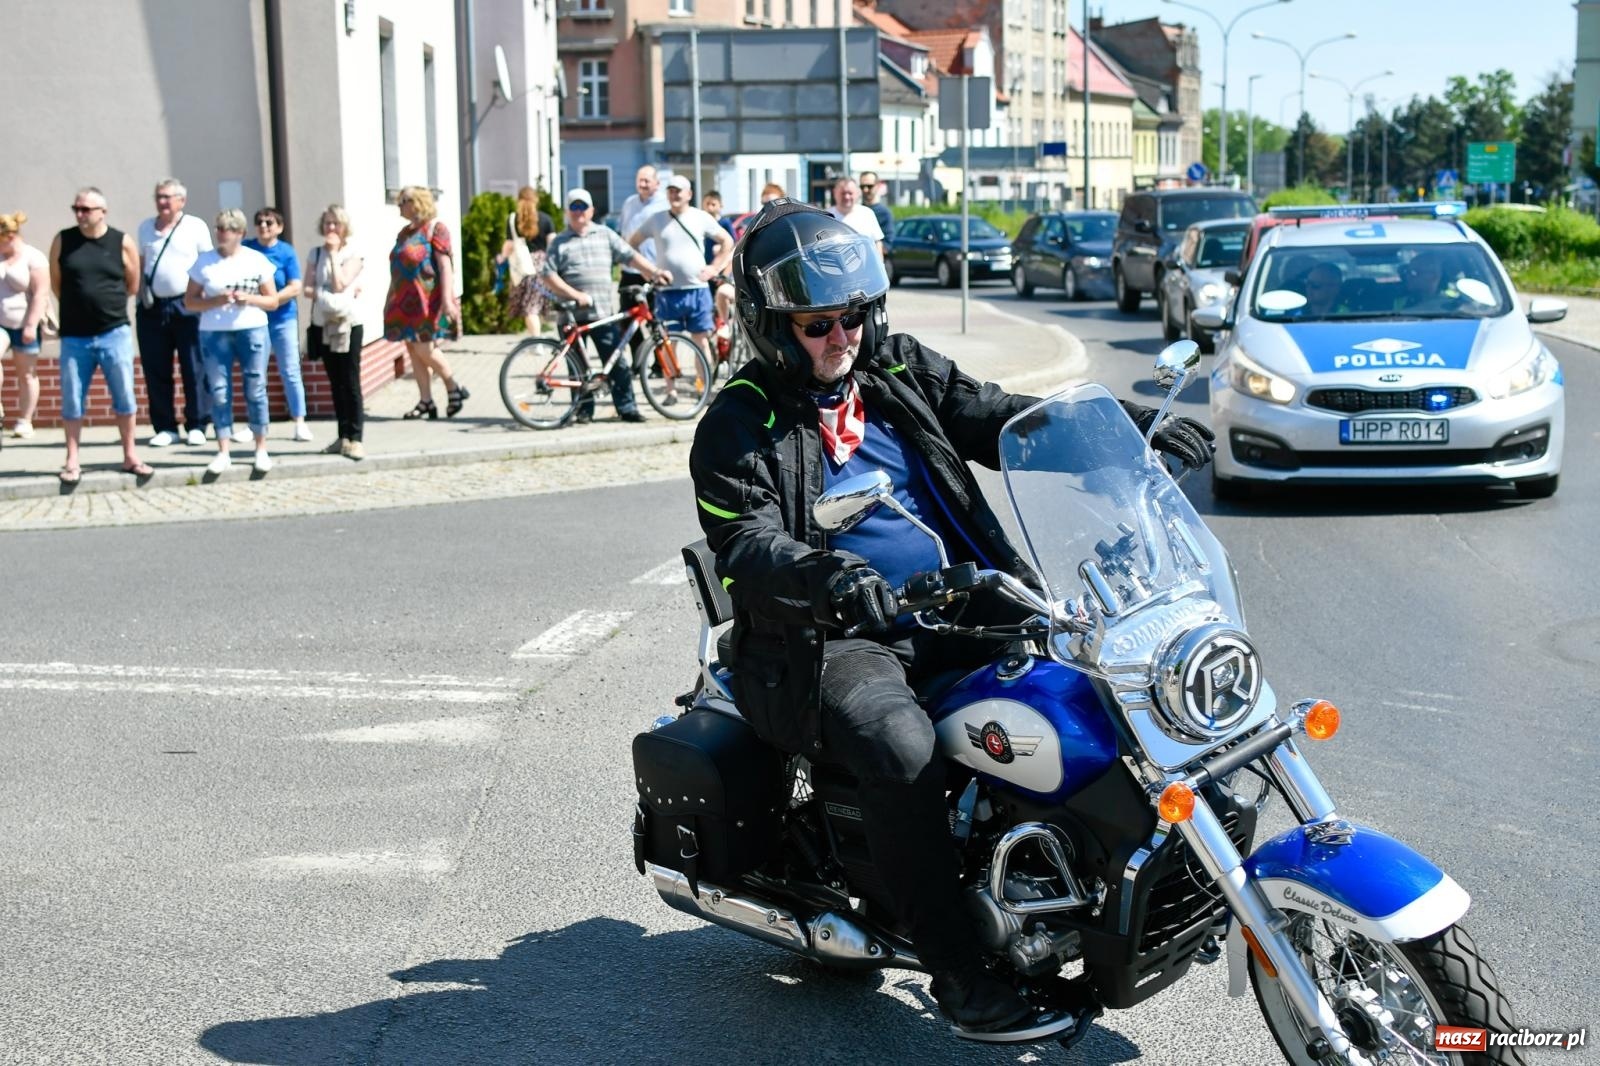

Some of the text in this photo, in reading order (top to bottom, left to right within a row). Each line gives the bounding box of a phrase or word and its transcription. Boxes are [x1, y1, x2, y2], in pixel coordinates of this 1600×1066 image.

[1333, 352, 1446, 368] POLICJA
[1352, 420, 1446, 440] HPP R014
[1283, 886, 1358, 925] Classic Deluxe
